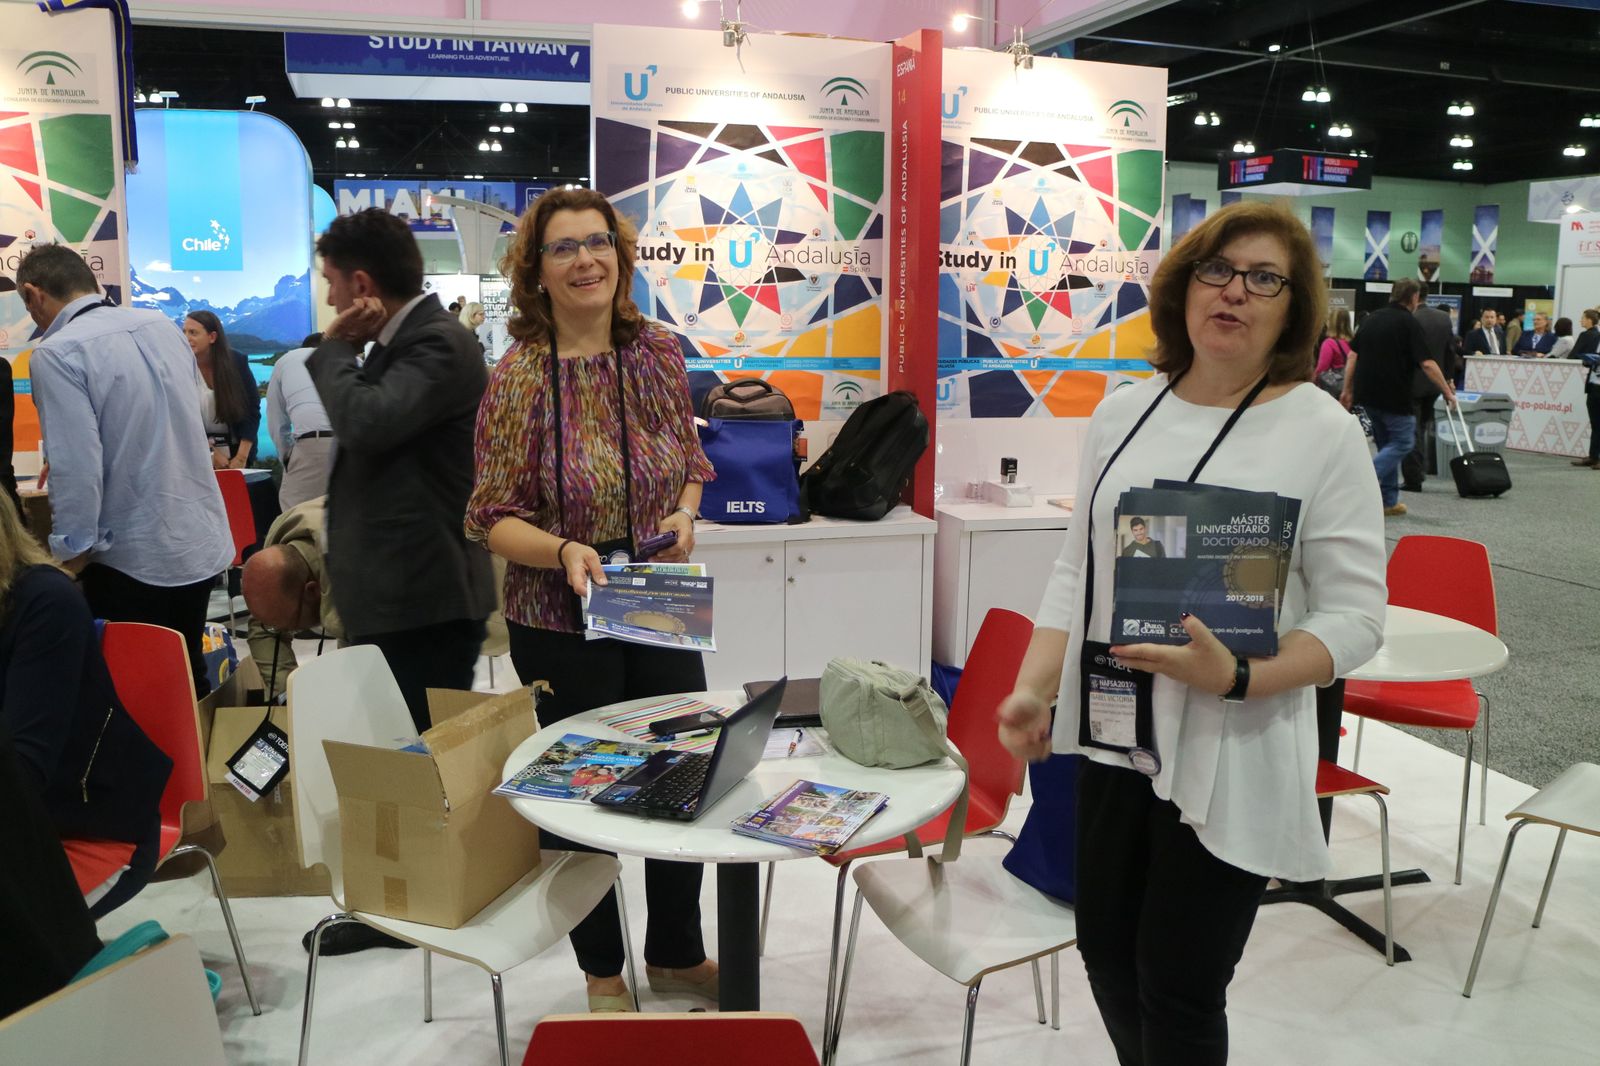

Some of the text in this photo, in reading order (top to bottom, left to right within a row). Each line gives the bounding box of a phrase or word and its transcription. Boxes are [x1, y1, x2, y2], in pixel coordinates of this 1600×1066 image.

[368, 34, 567, 55] STUDY IN TAIWAN
[17, 87, 38, 95] JUNTA
[40, 88, 48, 96] DE
[665, 86, 694, 95] PUBLIC
[696, 88, 748, 98] UNIVERSITIES
[761, 92, 806, 101] ANDALUSIA
[974, 106, 999, 114] PUBLIC
[901, 207, 908, 225] OF
[181, 237, 222, 252] Chile
[694, 243, 715, 262] in
[764, 245, 871, 266] Andalusia
[1000, 251, 1017, 269] in
[1060, 254, 1149, 275] Andalusia
[898, 324, 906, 373] PUBLIC
[726, 500, 766, 514] IELTS
[1230, 513, 1270, 525] MÁSTER
[1196, 524, 1270, 534] UNIVERSITARIO
[1202, 537, 1270, 547] DOCTORADO
